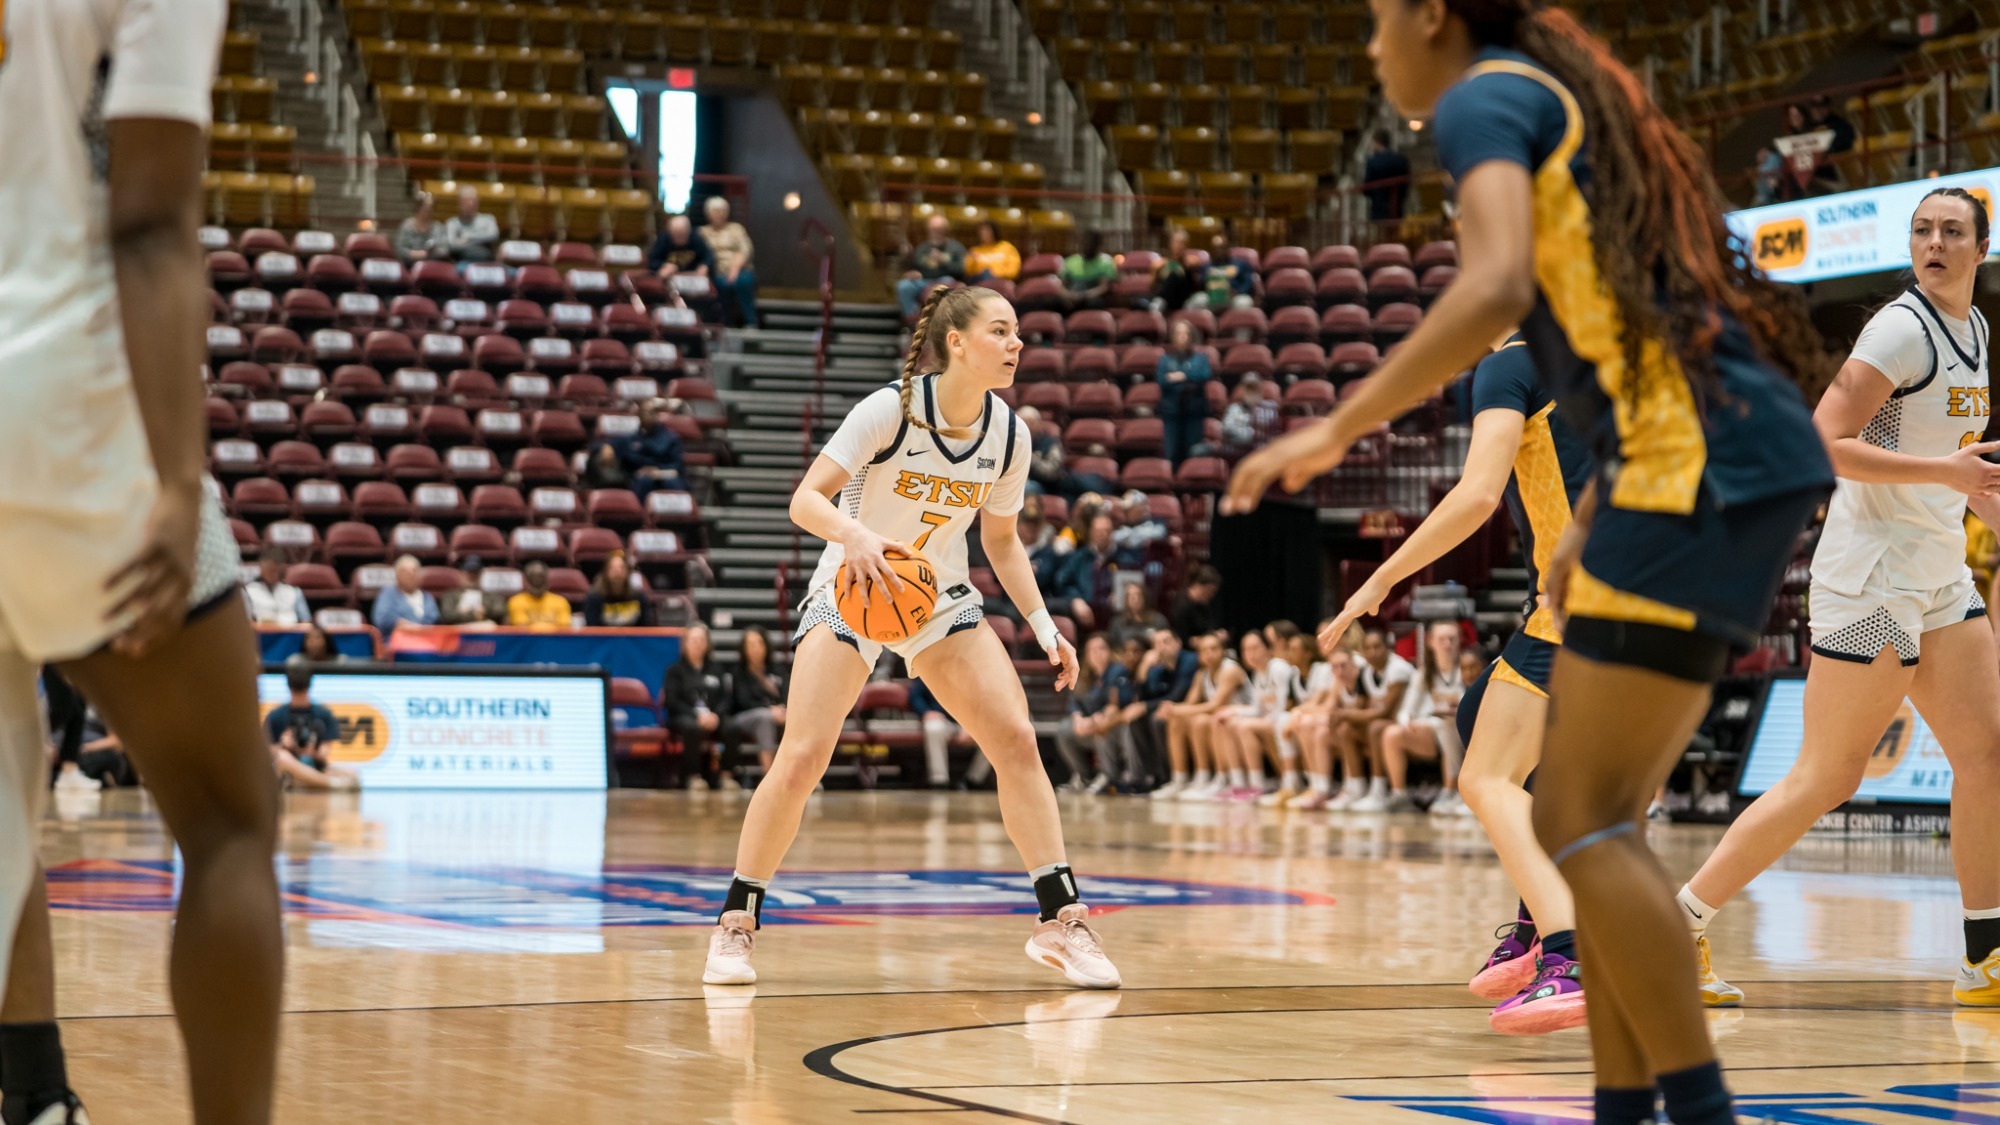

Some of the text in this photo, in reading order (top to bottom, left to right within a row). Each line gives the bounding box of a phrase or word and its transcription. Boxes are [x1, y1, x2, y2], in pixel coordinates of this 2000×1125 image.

[893, 470, 993, 508] ETSU
[913, 511, 952, 551] 7
[406, 696, 551, 719] SOUTHERN
[407, 726, 553, 747] CONCRETE
[409, 755, 554, 772] MATERIALS
[1848, 813, 1894, 830] CENTER
